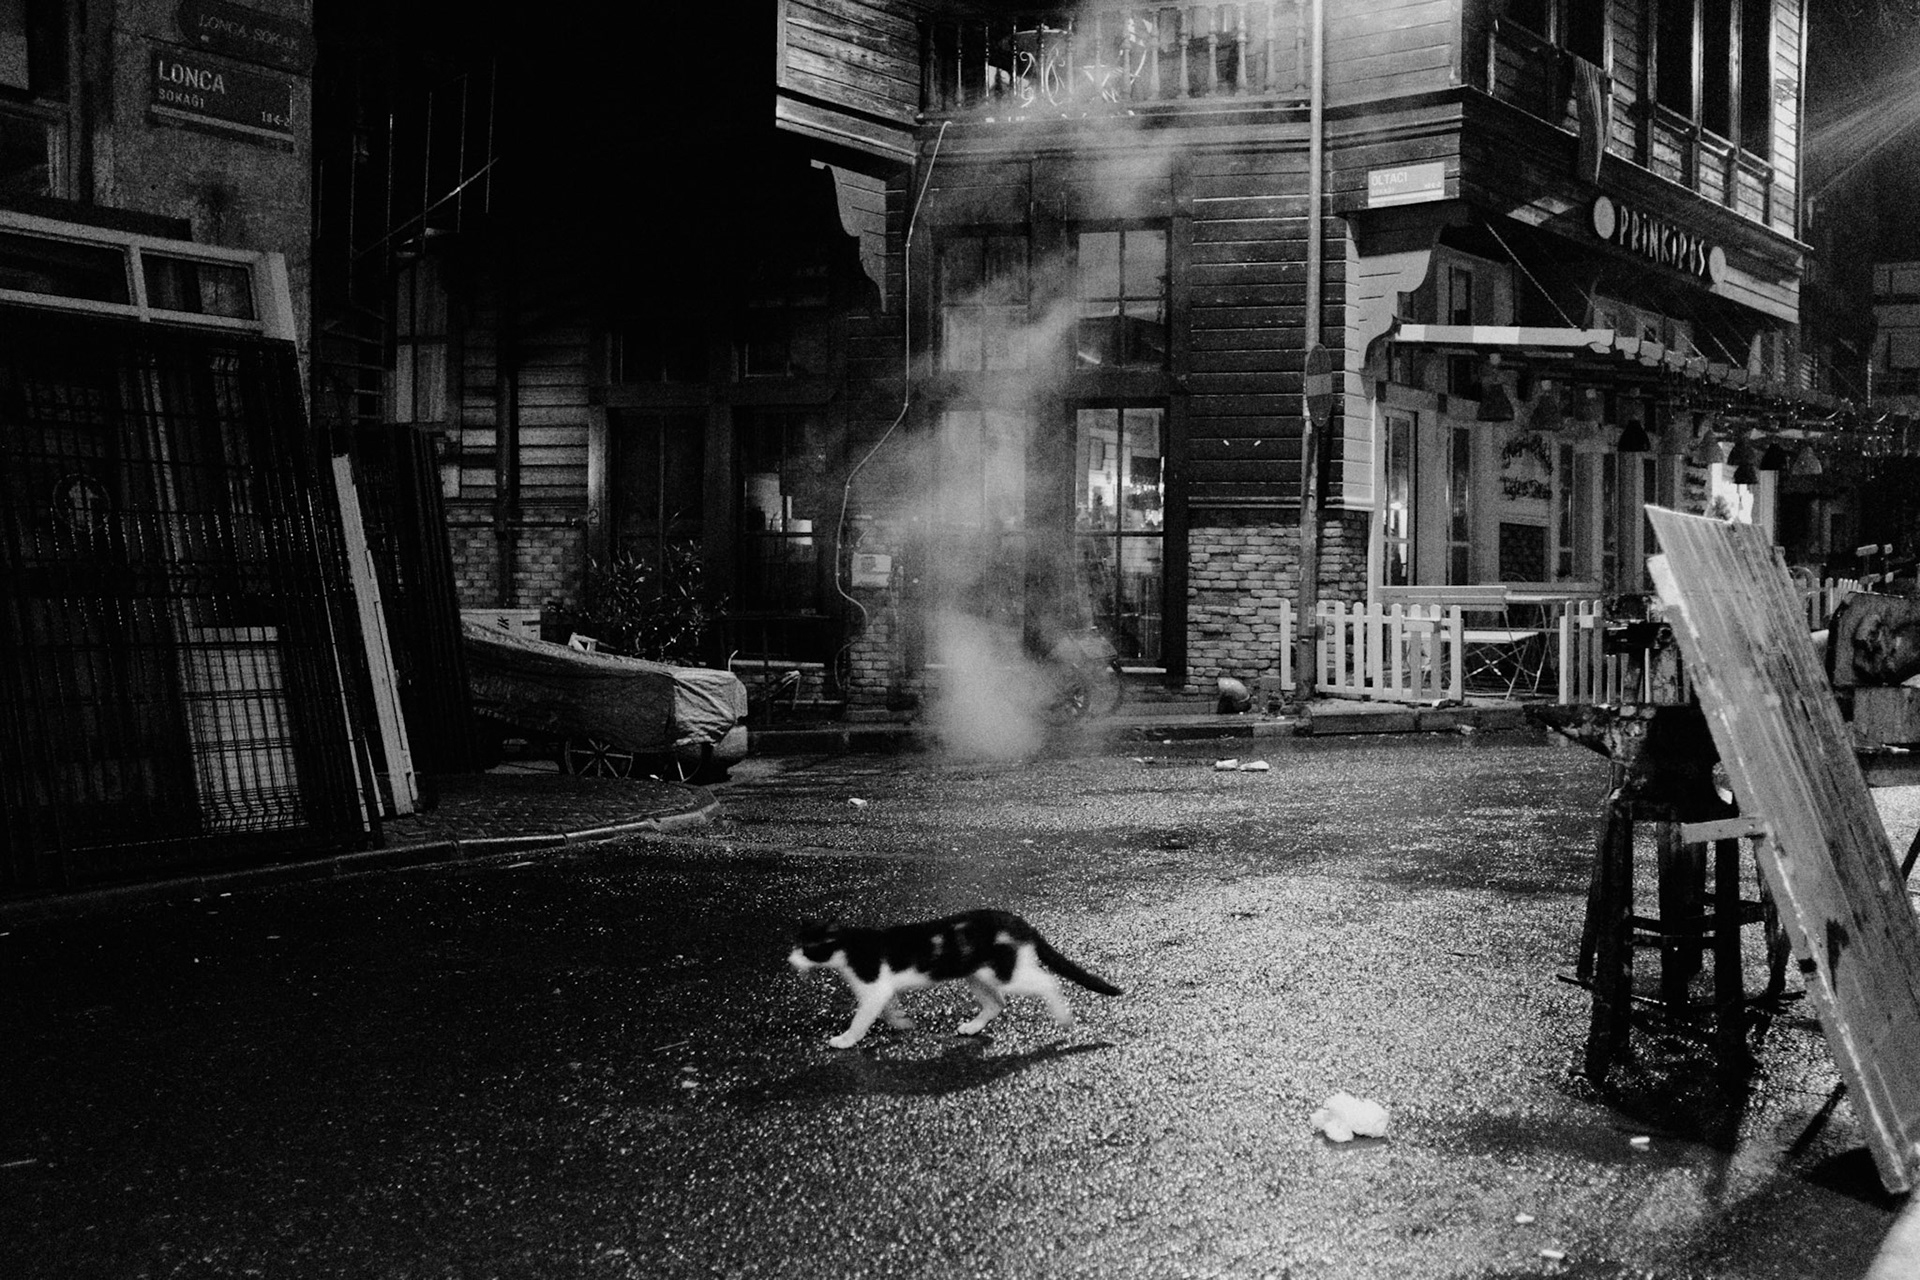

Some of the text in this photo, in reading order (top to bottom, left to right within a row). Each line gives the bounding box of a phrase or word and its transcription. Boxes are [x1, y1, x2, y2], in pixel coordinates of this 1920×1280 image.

[198, 13, 248, 38] LONCA
[158, 60, 225, 95] LONCA
[158, 87, 205, 109] SOKAĞI
[1371, 171, 1408, 187] OLTACI
[589, 508, 599, 525] 2
